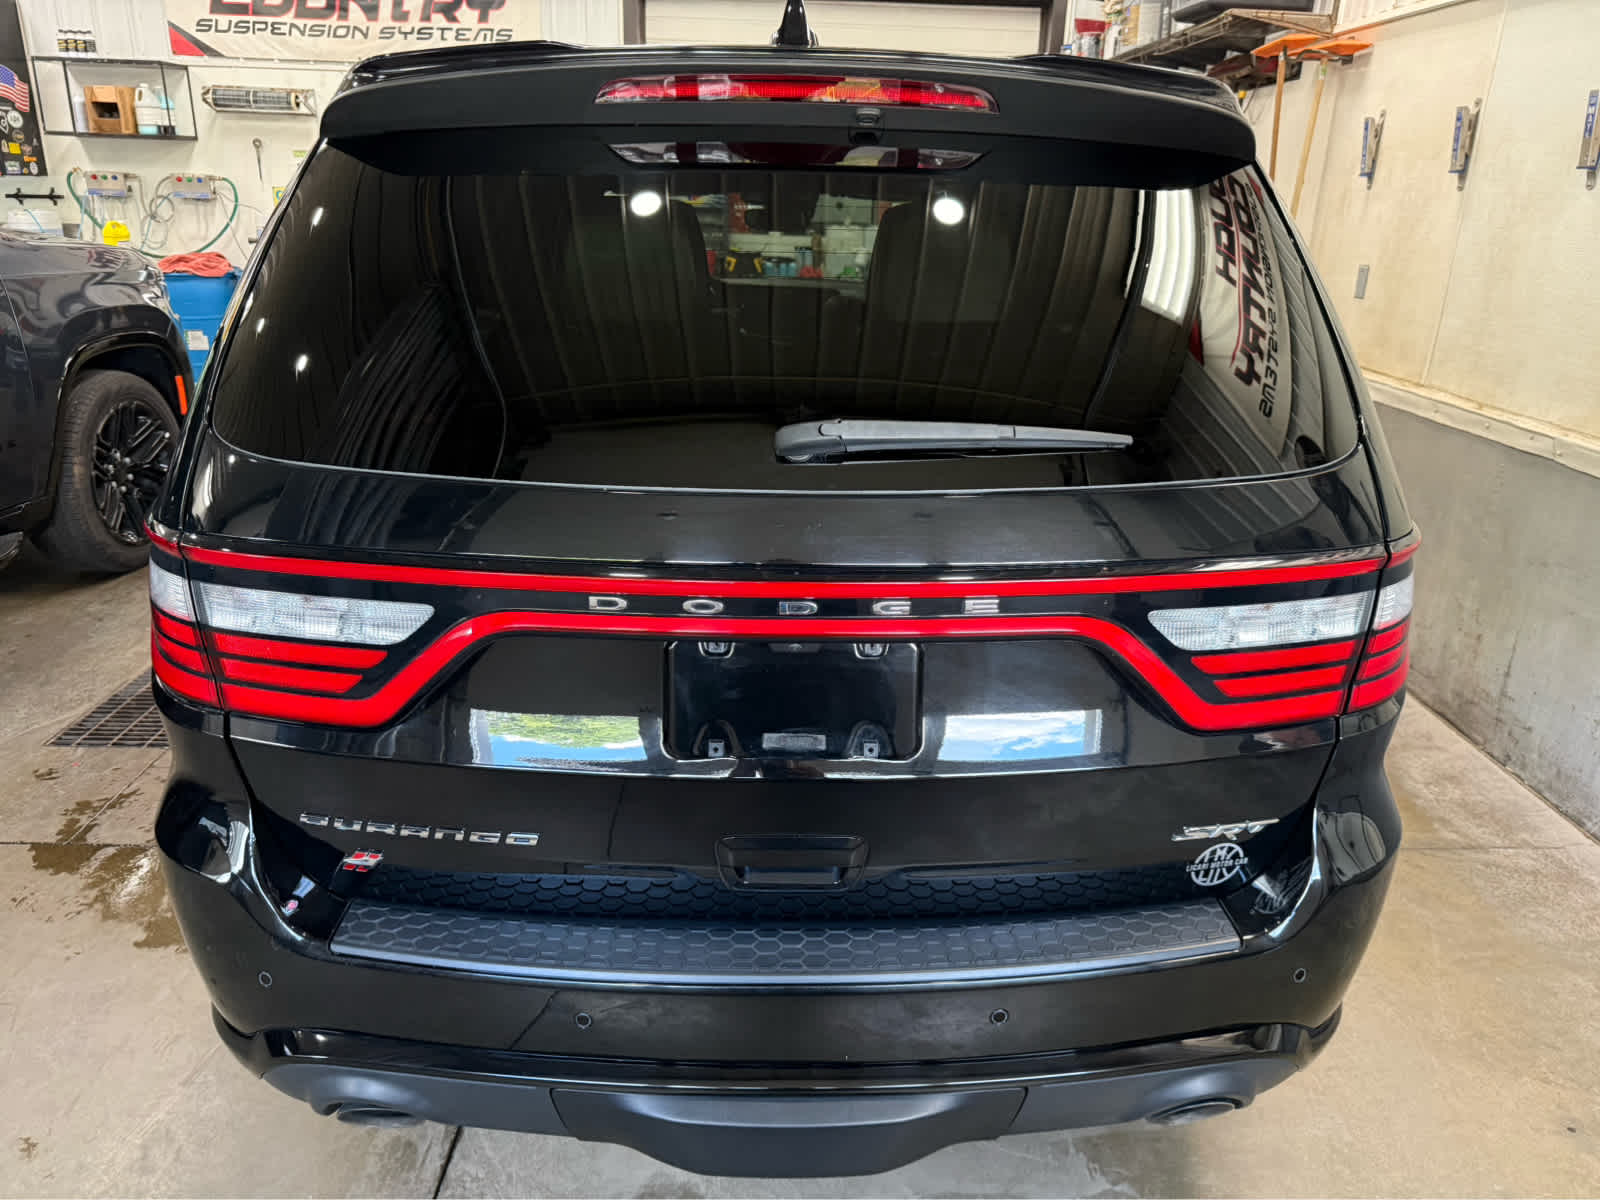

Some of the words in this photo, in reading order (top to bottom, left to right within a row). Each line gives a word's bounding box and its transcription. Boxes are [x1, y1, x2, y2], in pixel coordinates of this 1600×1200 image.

[195, 18, 370, 41] SUSPENSION
[378, 26, 513, 42] SYSTEMS
[588, 595, 1000, 616] DODGE
[298, 811, 540, 847] DURANGO
[1170, 818, 1281, 842] SRT
